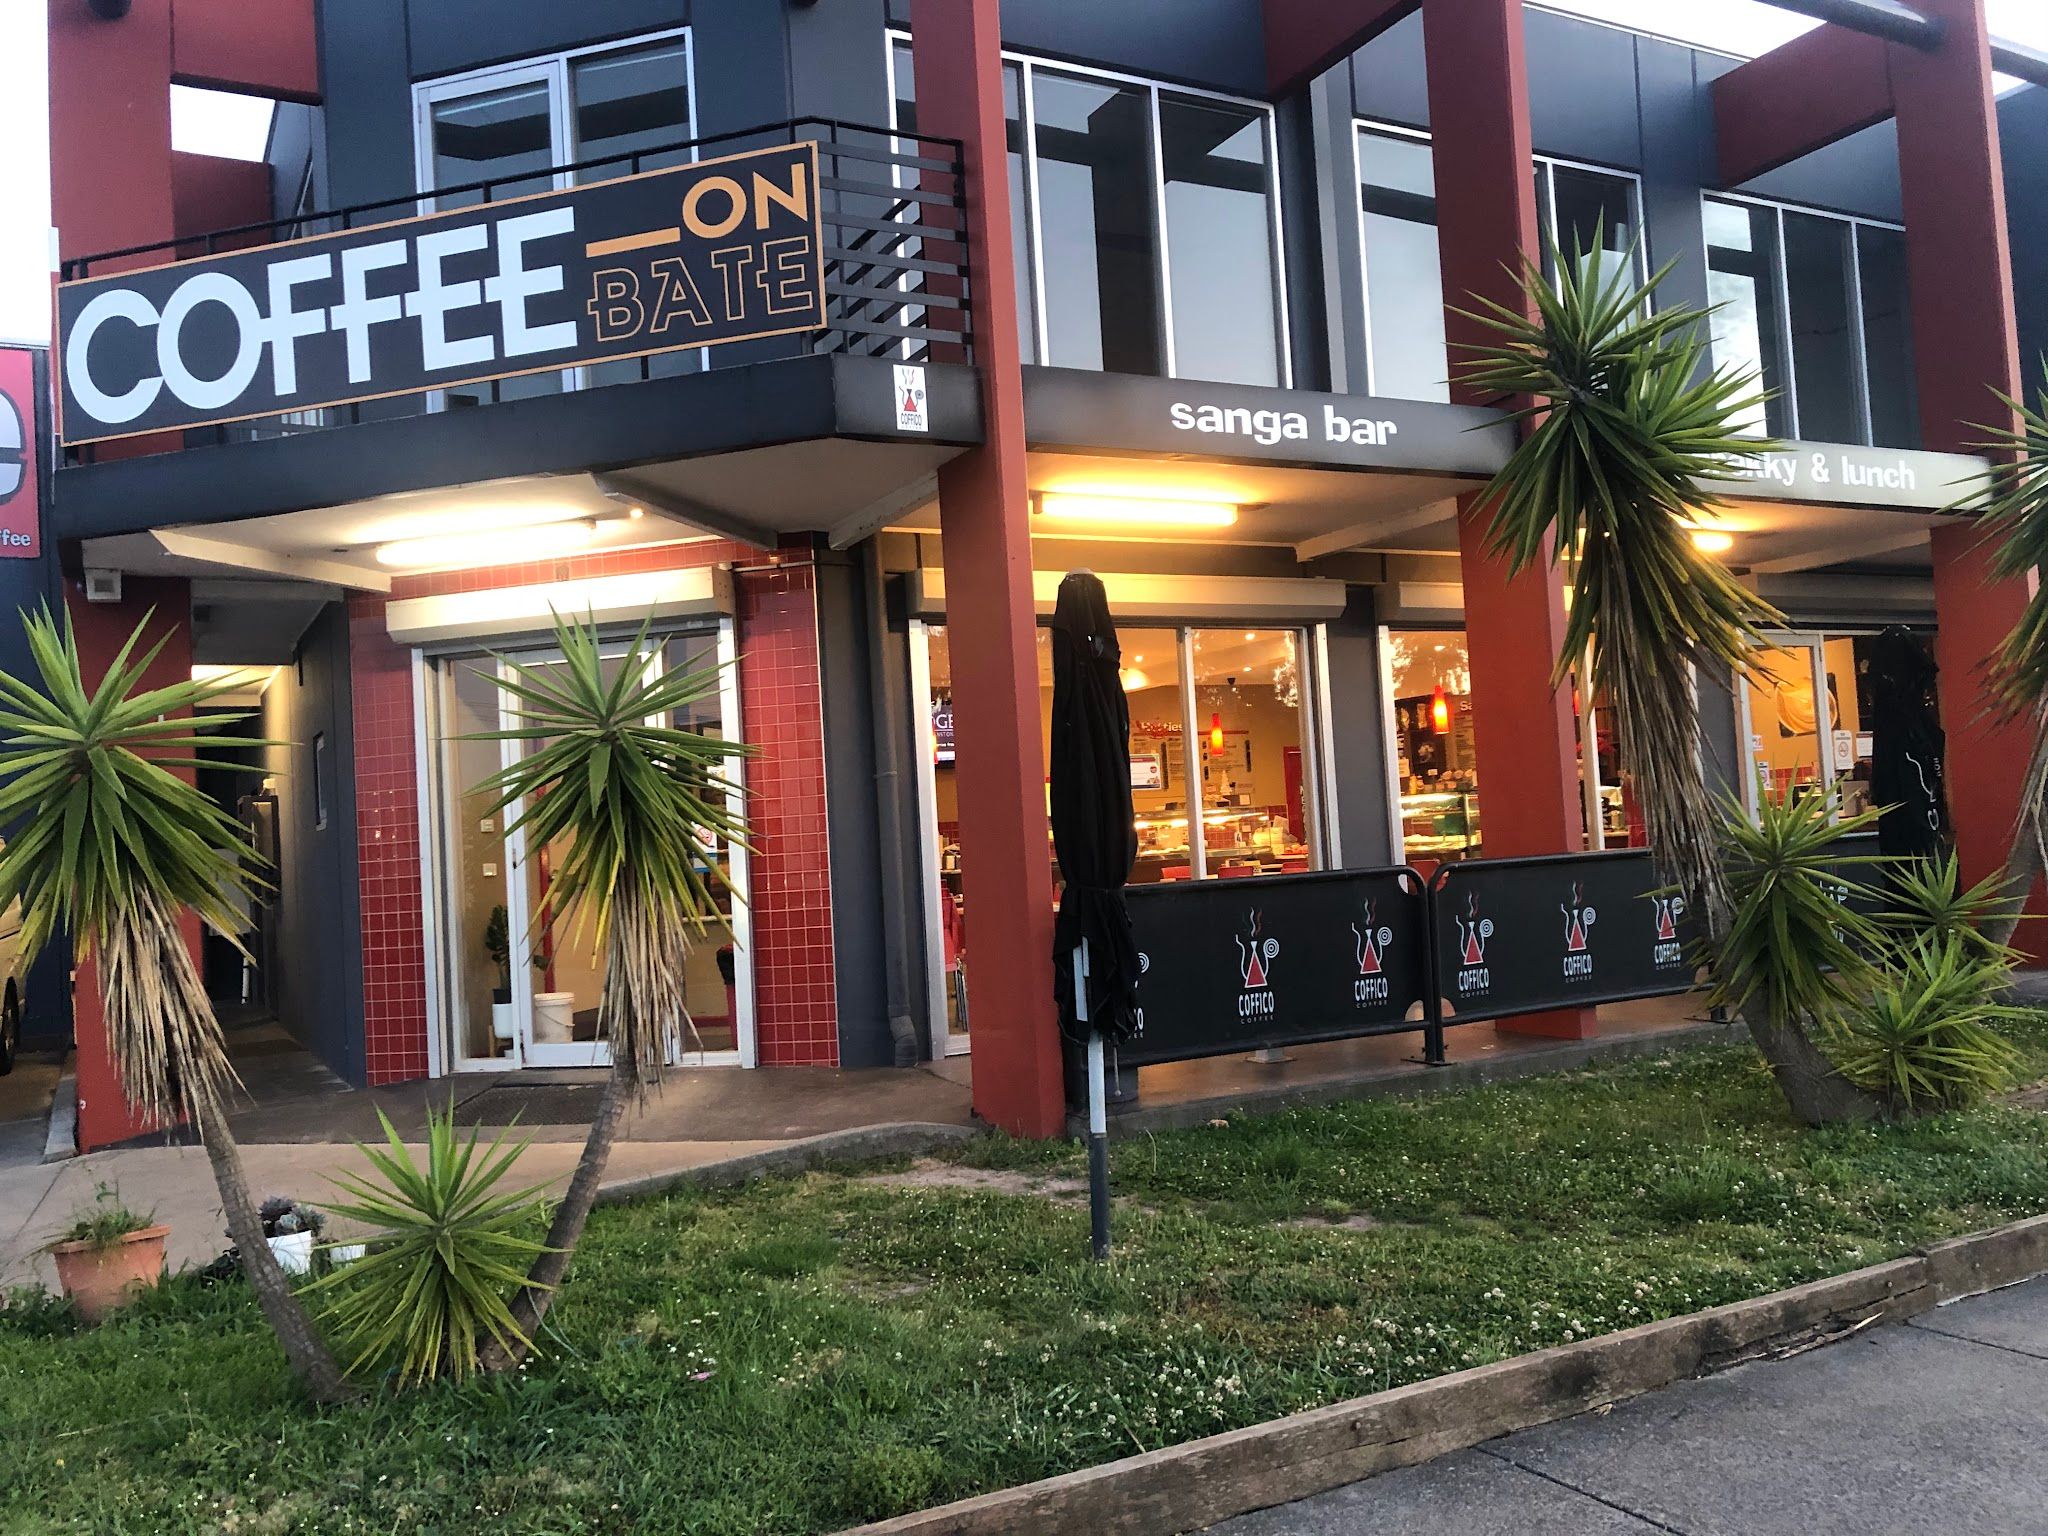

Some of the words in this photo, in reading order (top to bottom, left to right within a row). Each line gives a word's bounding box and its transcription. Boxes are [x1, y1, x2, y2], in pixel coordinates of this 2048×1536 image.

[682, 163, 808, 238] ON
[587, 235, 814, 342] BATE
[66, 206, 578, 424] COFFEE
[1170, 402, 1308, 445] sanga
[1323, 404, 1397, 445] bar
[1811, 452, 1830, 483] &
[1842, 455, 1915, 489] lunch
[0, 528, 31, 546] fee
[1563, 954, 1592, 976] COFFICO
[1354, 977, 1388, 1001] COFFICO
[1458, 967, 1490, 991] COFFICO
[1238, 991, 1275, 1016] COFFICO
[1240, 1015, 1274, 1024] COFFEE
